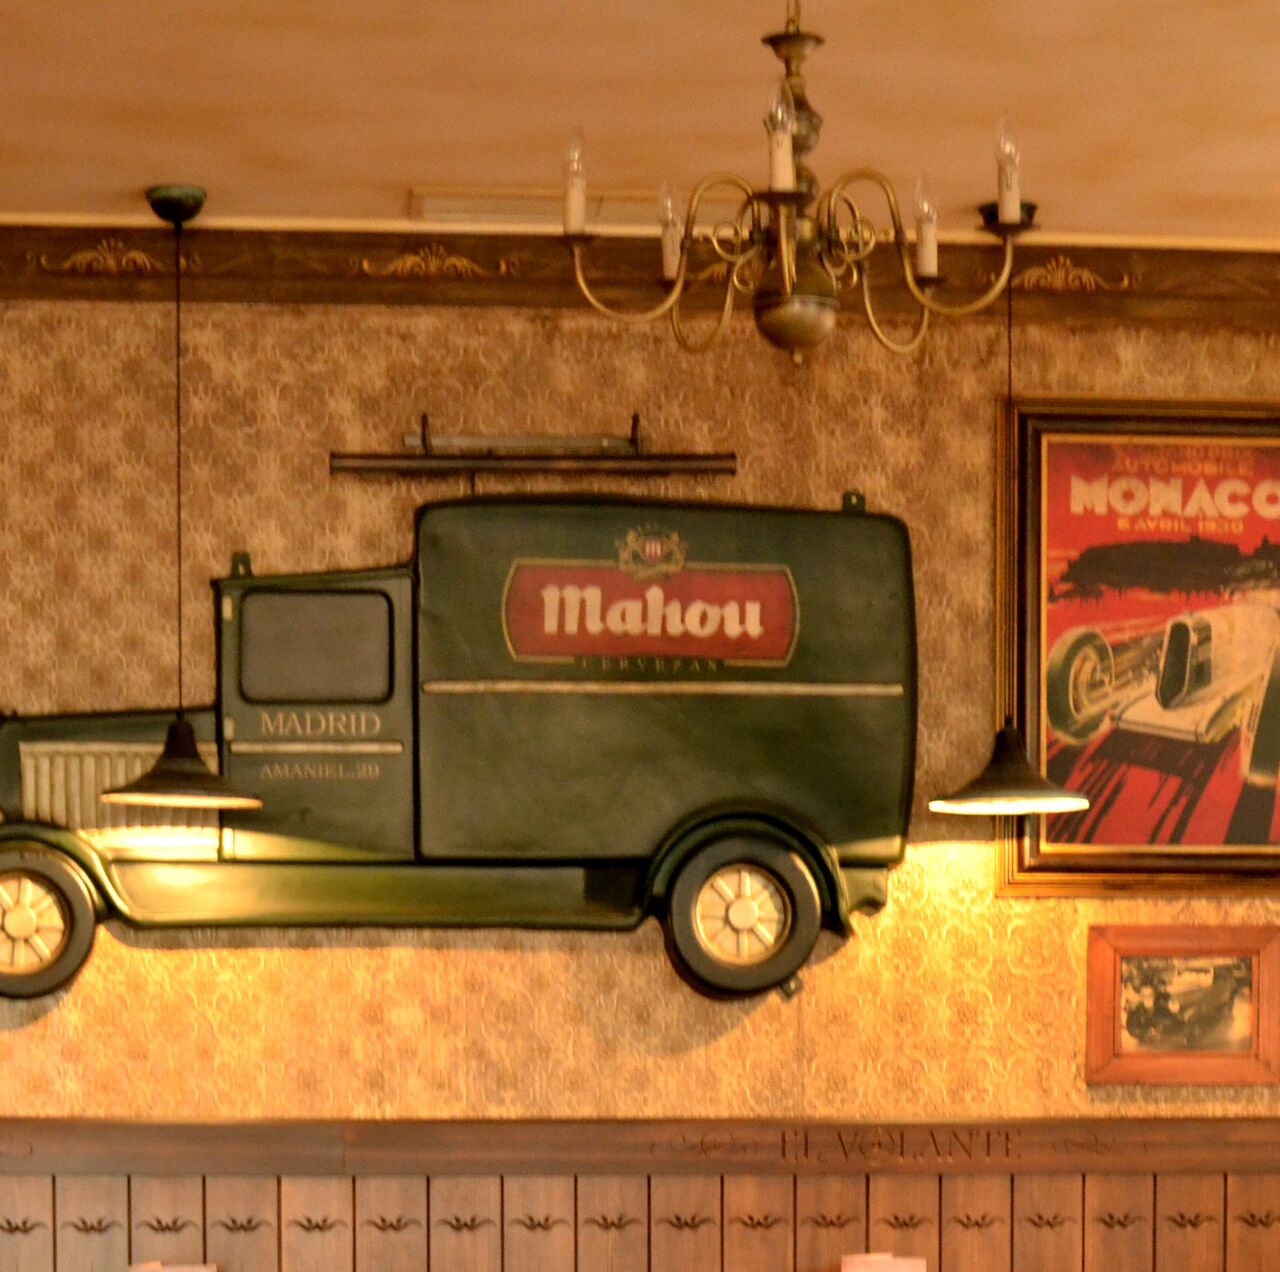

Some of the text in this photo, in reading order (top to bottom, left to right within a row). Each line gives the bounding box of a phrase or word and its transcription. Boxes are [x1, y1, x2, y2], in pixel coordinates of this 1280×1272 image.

[1133, 517, 1190, 533] AVRIL
[541, 584, 764, 639] Mahou
[260, 710, 382, 737] MADRID
[780, 1128, 1022, 1163] EL VOLANTE
